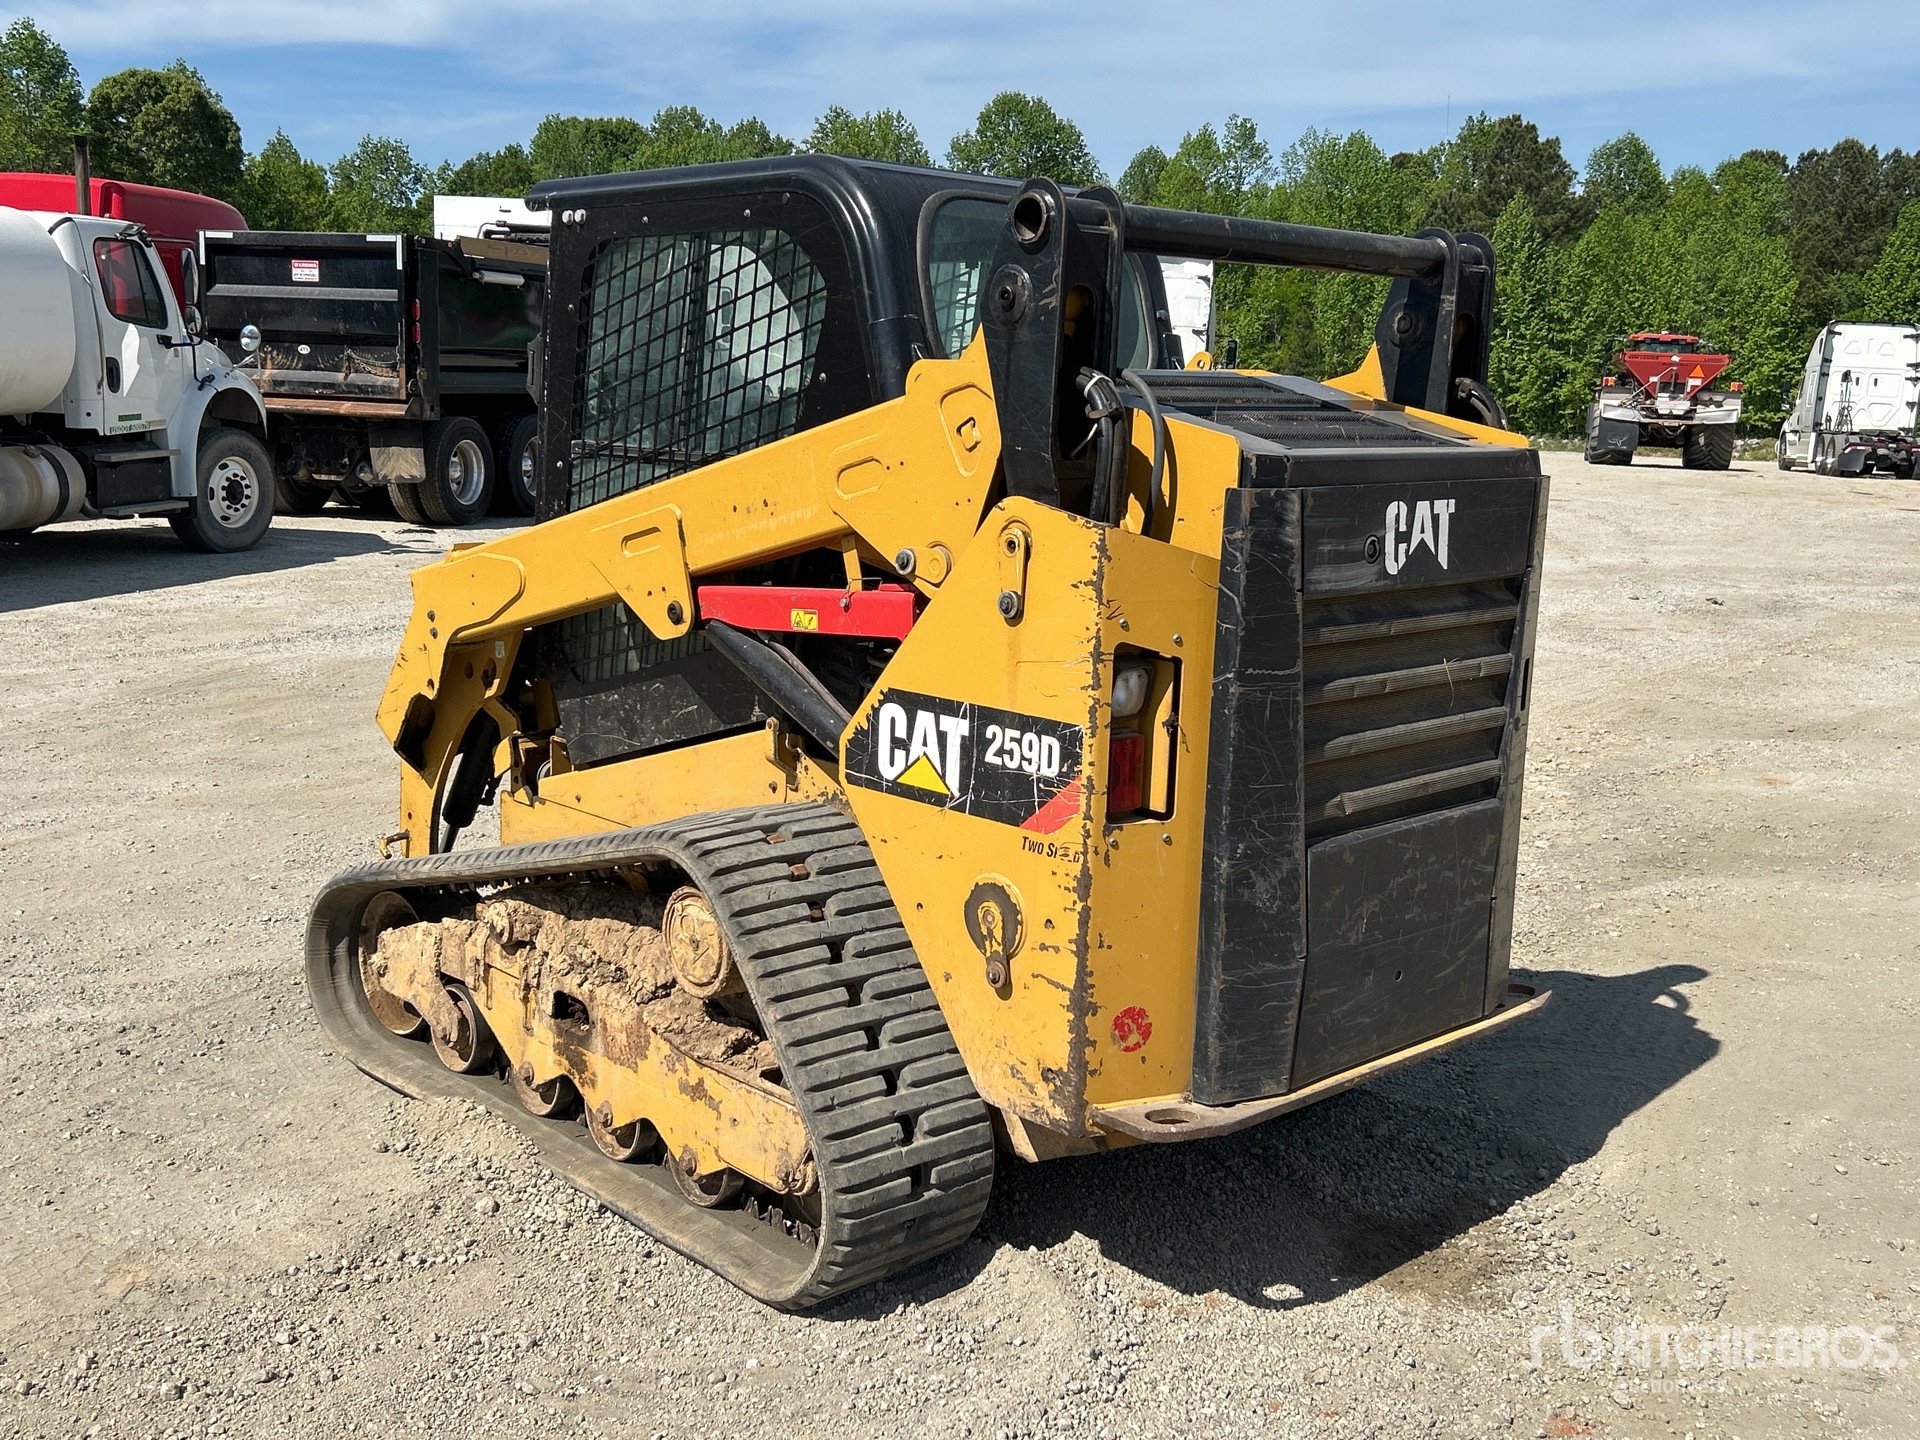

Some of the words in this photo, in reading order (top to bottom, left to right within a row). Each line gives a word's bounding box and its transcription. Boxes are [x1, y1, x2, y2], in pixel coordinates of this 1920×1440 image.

[1385, 499, 1455, 575] CAT
[878, 702, 969, 798] CAT
[984, 725, 1060, 778] 259D
